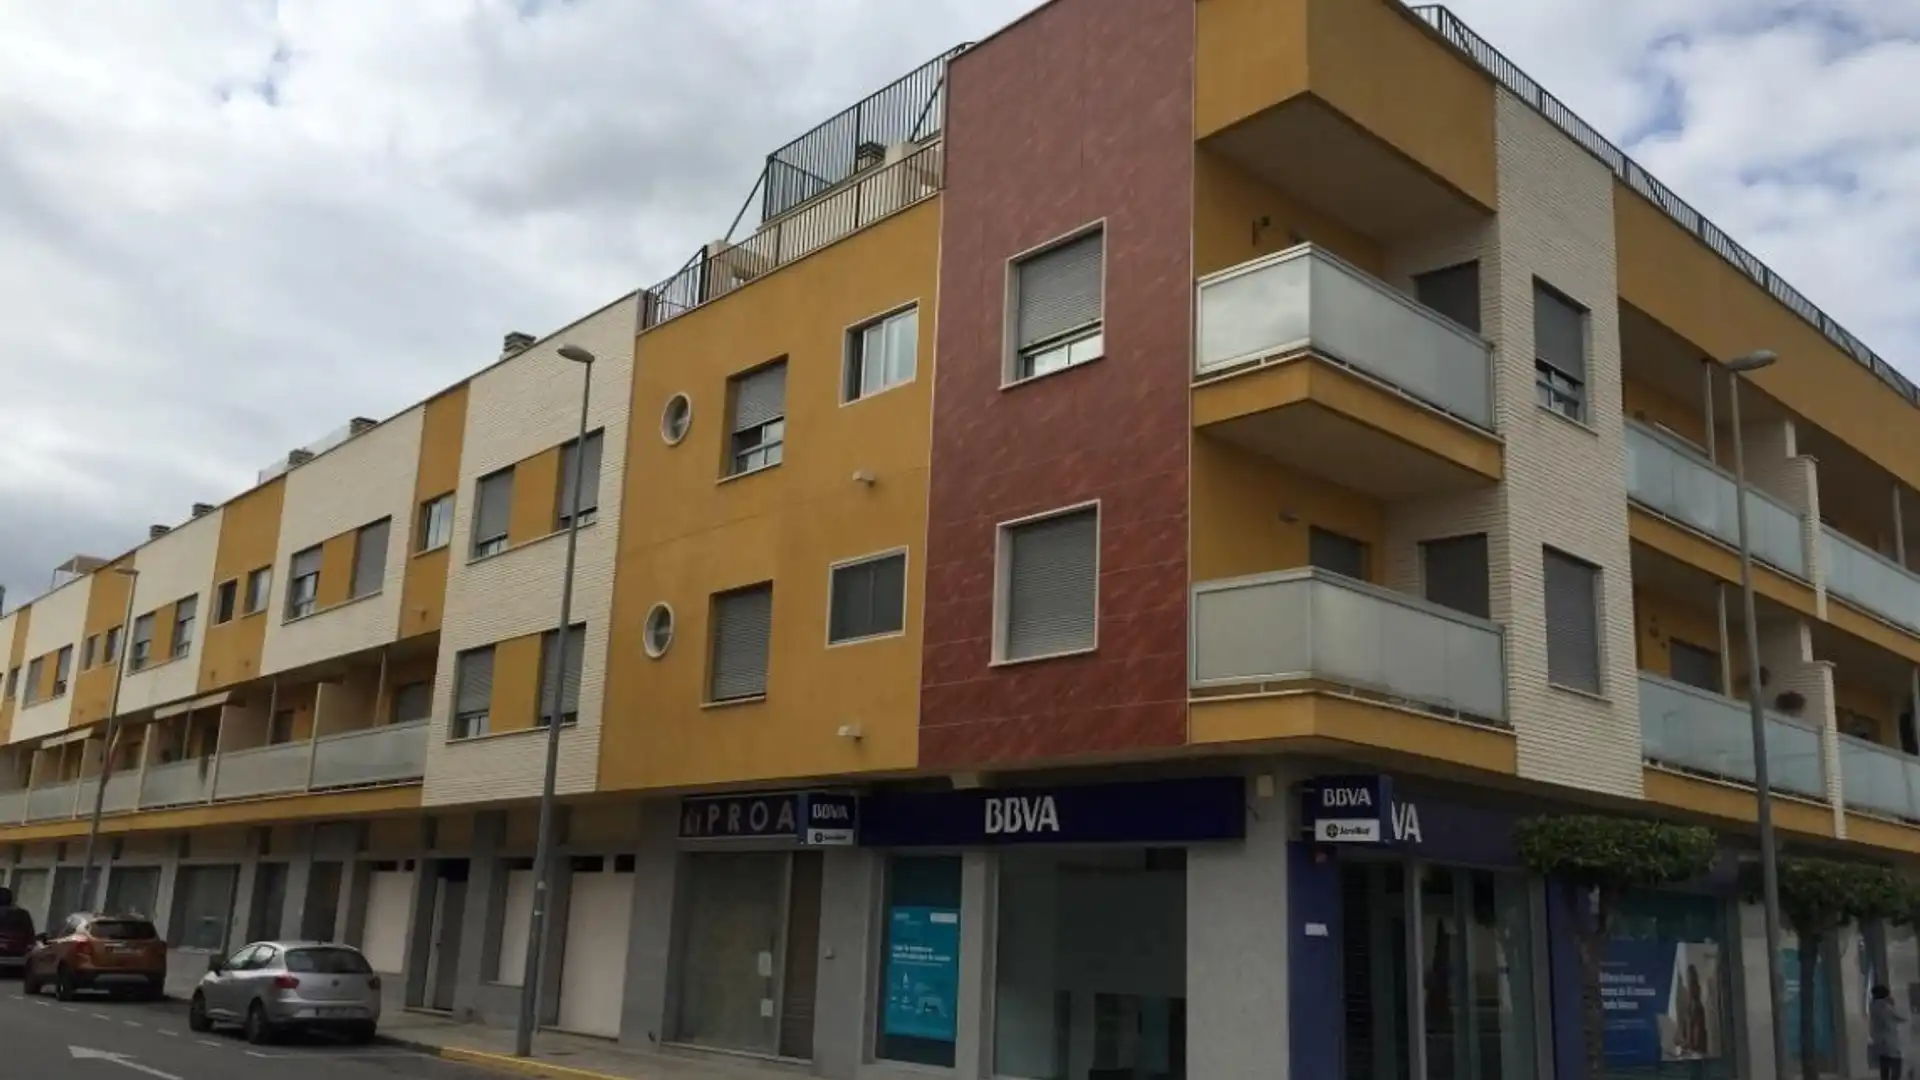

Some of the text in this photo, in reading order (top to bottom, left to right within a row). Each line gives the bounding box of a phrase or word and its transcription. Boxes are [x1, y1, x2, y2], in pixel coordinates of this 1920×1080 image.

[1322, 787, 1373, 806] BBVA
[707, 800, 796, 834] PROA
[812, 804, 849, 821] BBVA
[984, 795, 1060, 834] BBVA
